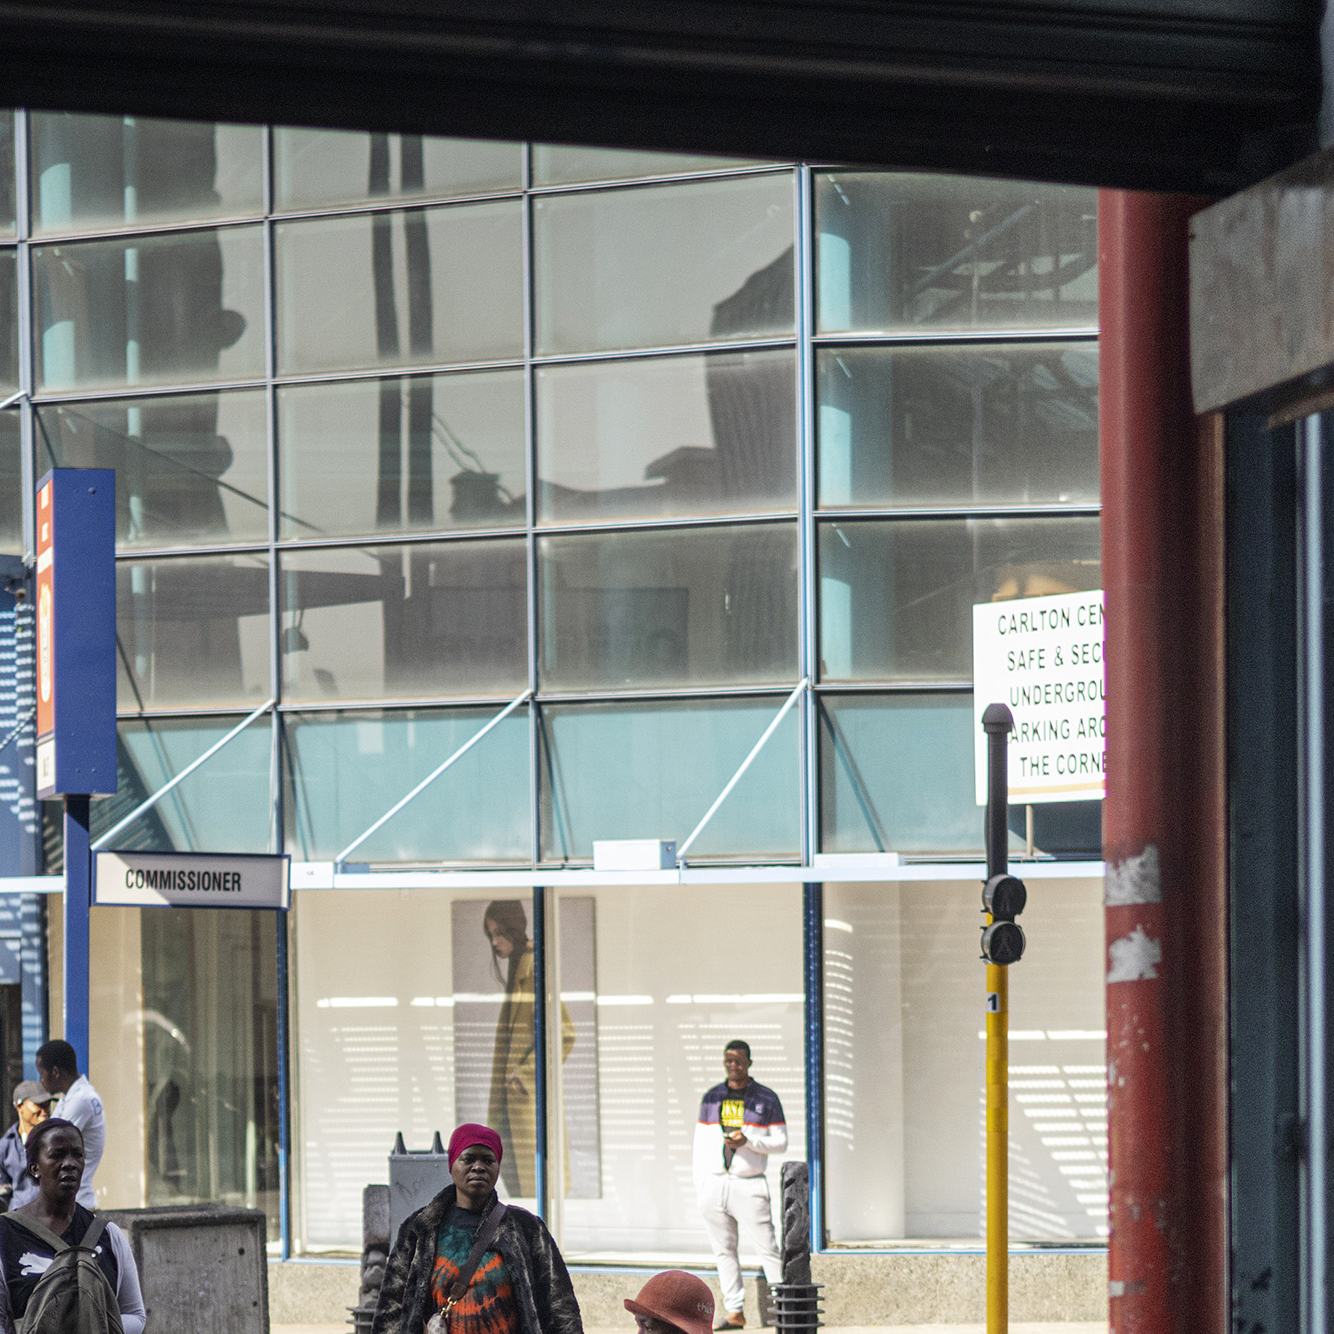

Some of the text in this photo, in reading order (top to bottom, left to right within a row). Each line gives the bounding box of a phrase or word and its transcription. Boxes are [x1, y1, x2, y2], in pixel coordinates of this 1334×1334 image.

[997, 606, 1071, 636] CARLTON
[1007, 648, 1046, 672] SAFE
[1053, 645, 1064, 667] &
[1008, 718, 1071, 745] ARKING
[1020, 754, 1050, 777] THE
[125, 869, 242, 892] COMMISSIONER
[987, 993, 997, 1011] 1
